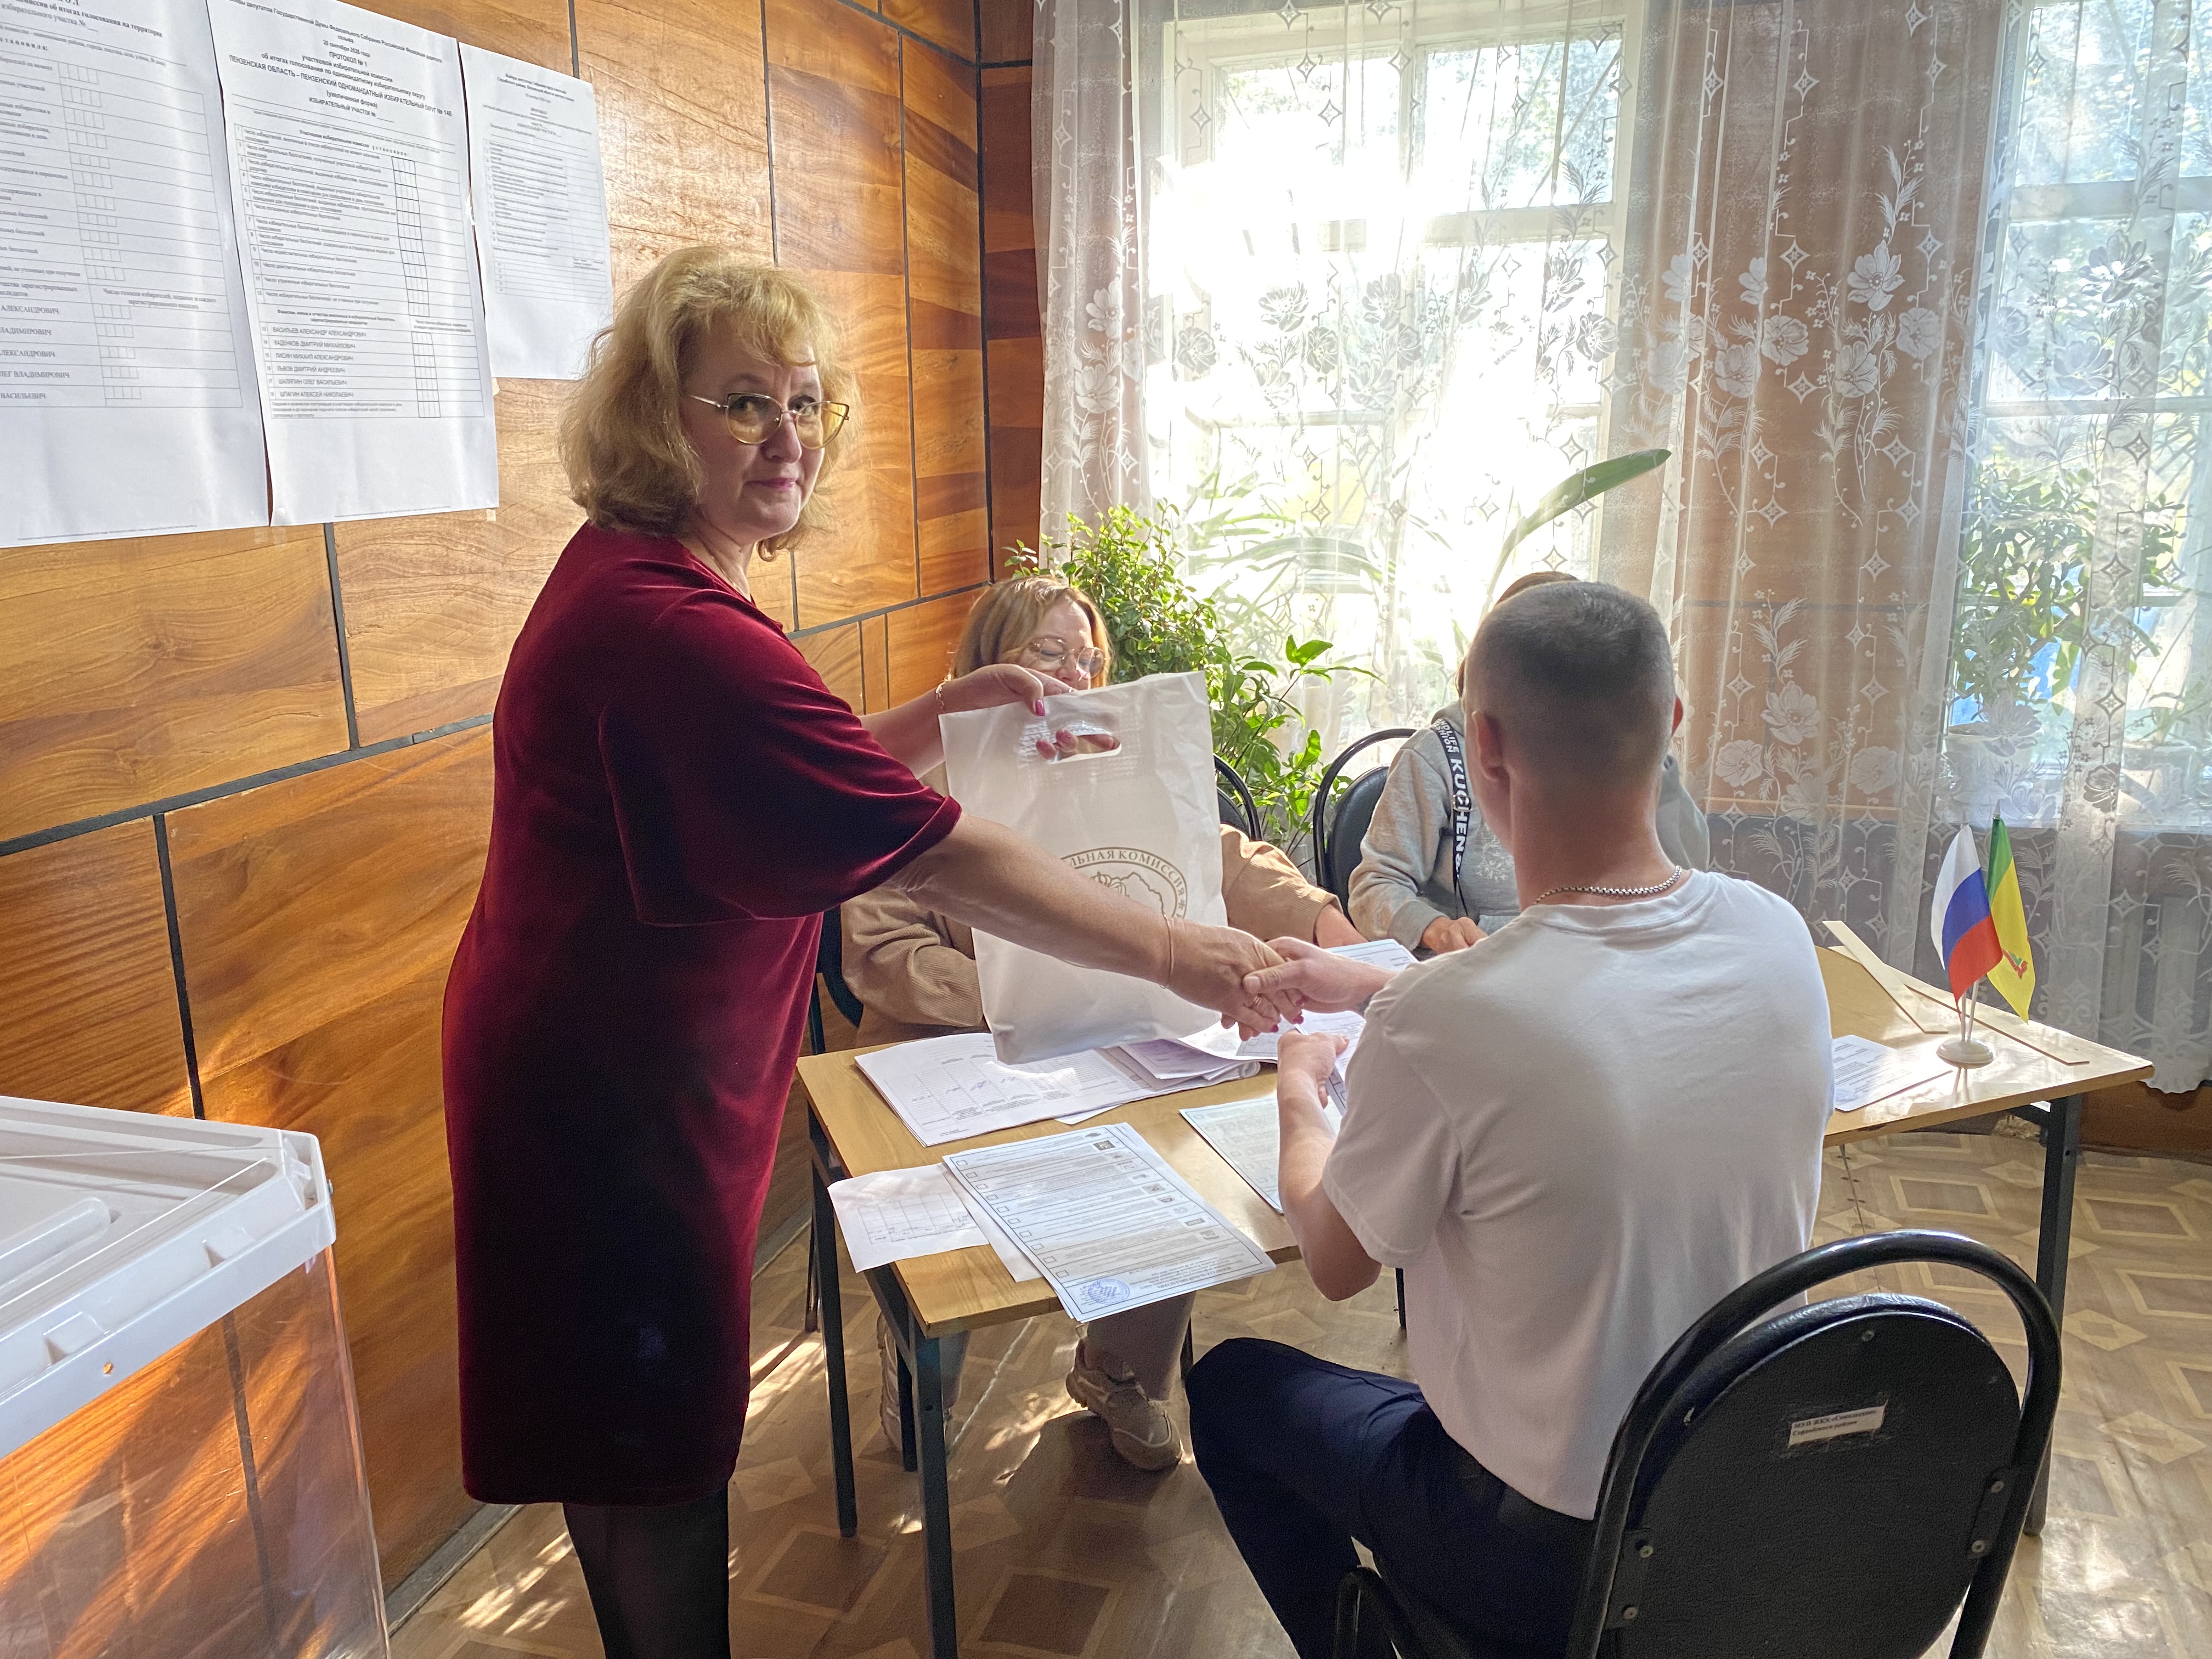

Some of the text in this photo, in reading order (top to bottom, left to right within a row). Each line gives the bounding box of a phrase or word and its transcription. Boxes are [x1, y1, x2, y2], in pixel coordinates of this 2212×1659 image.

[1, 3, 53, 19] избирательного
[59, 6, 81, 16] итогах
[82, 12, 121, 26] голосования
[270, 55, 288, 64] итогах
[290, 60, 324, 72] голосования
[302, 55, 332, 66] участковой
[333, 63, 370, 77] избирательной
[329, 52, 357, 64] ПРОТОКОЛ
[229, 54, 266, 70] ПЕНЗЕНСКАЯ
[267, 65, 295, 77] ОБЛАСТЬ
[301, 72, 337, 87] ПЕНЗЕНСКИЙ
[338, 82, 383, 99] ОДНОМАНДАТНЫЙ
[384, 94, 424, 110] ИЗБИРАТЕЛЬНЫЙ
[308, 97, 351, 111] ИЗБИРАТЕЛЬНЫЙ
[351, 106, 371, 116] УЧАСТОК
[0, 327, 52, 335] ЛАДИМИРОВИЧ
[1435, 725, 1454, 753] SHION
[1438, 719, 1459, 753] NDLIFE
[1119, 850, 1185, 896] КОМИССИЯ
